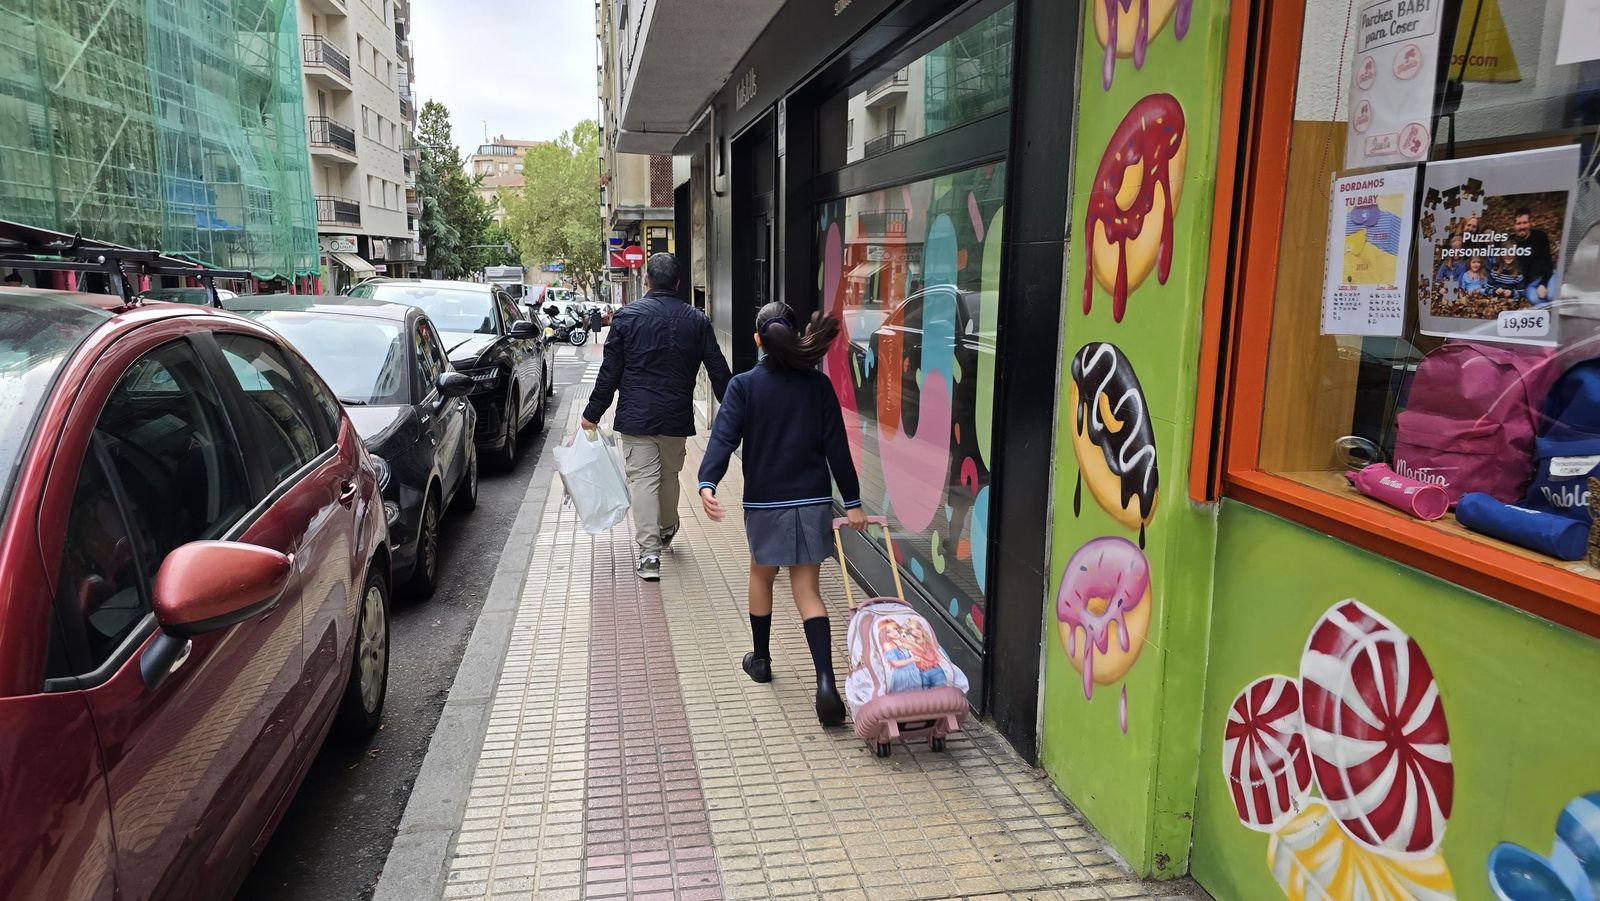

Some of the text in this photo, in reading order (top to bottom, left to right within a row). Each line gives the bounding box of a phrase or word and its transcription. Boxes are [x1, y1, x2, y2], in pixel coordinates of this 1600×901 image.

[1361, 8, 1394, 29] Parches
[1364, 19, 1420, 48] para Coser
[1339, 177, 1385, 193] BORDAMOS
[1345, 194, 1379, 207] TU BABY
[1462, 231, 1508, 243] Puzzles
[1441, 245, 1532, 260] personalizados
[1502, 317, 1544, 331] 19,95€
[1396, 458, 1450, 487] Martina
